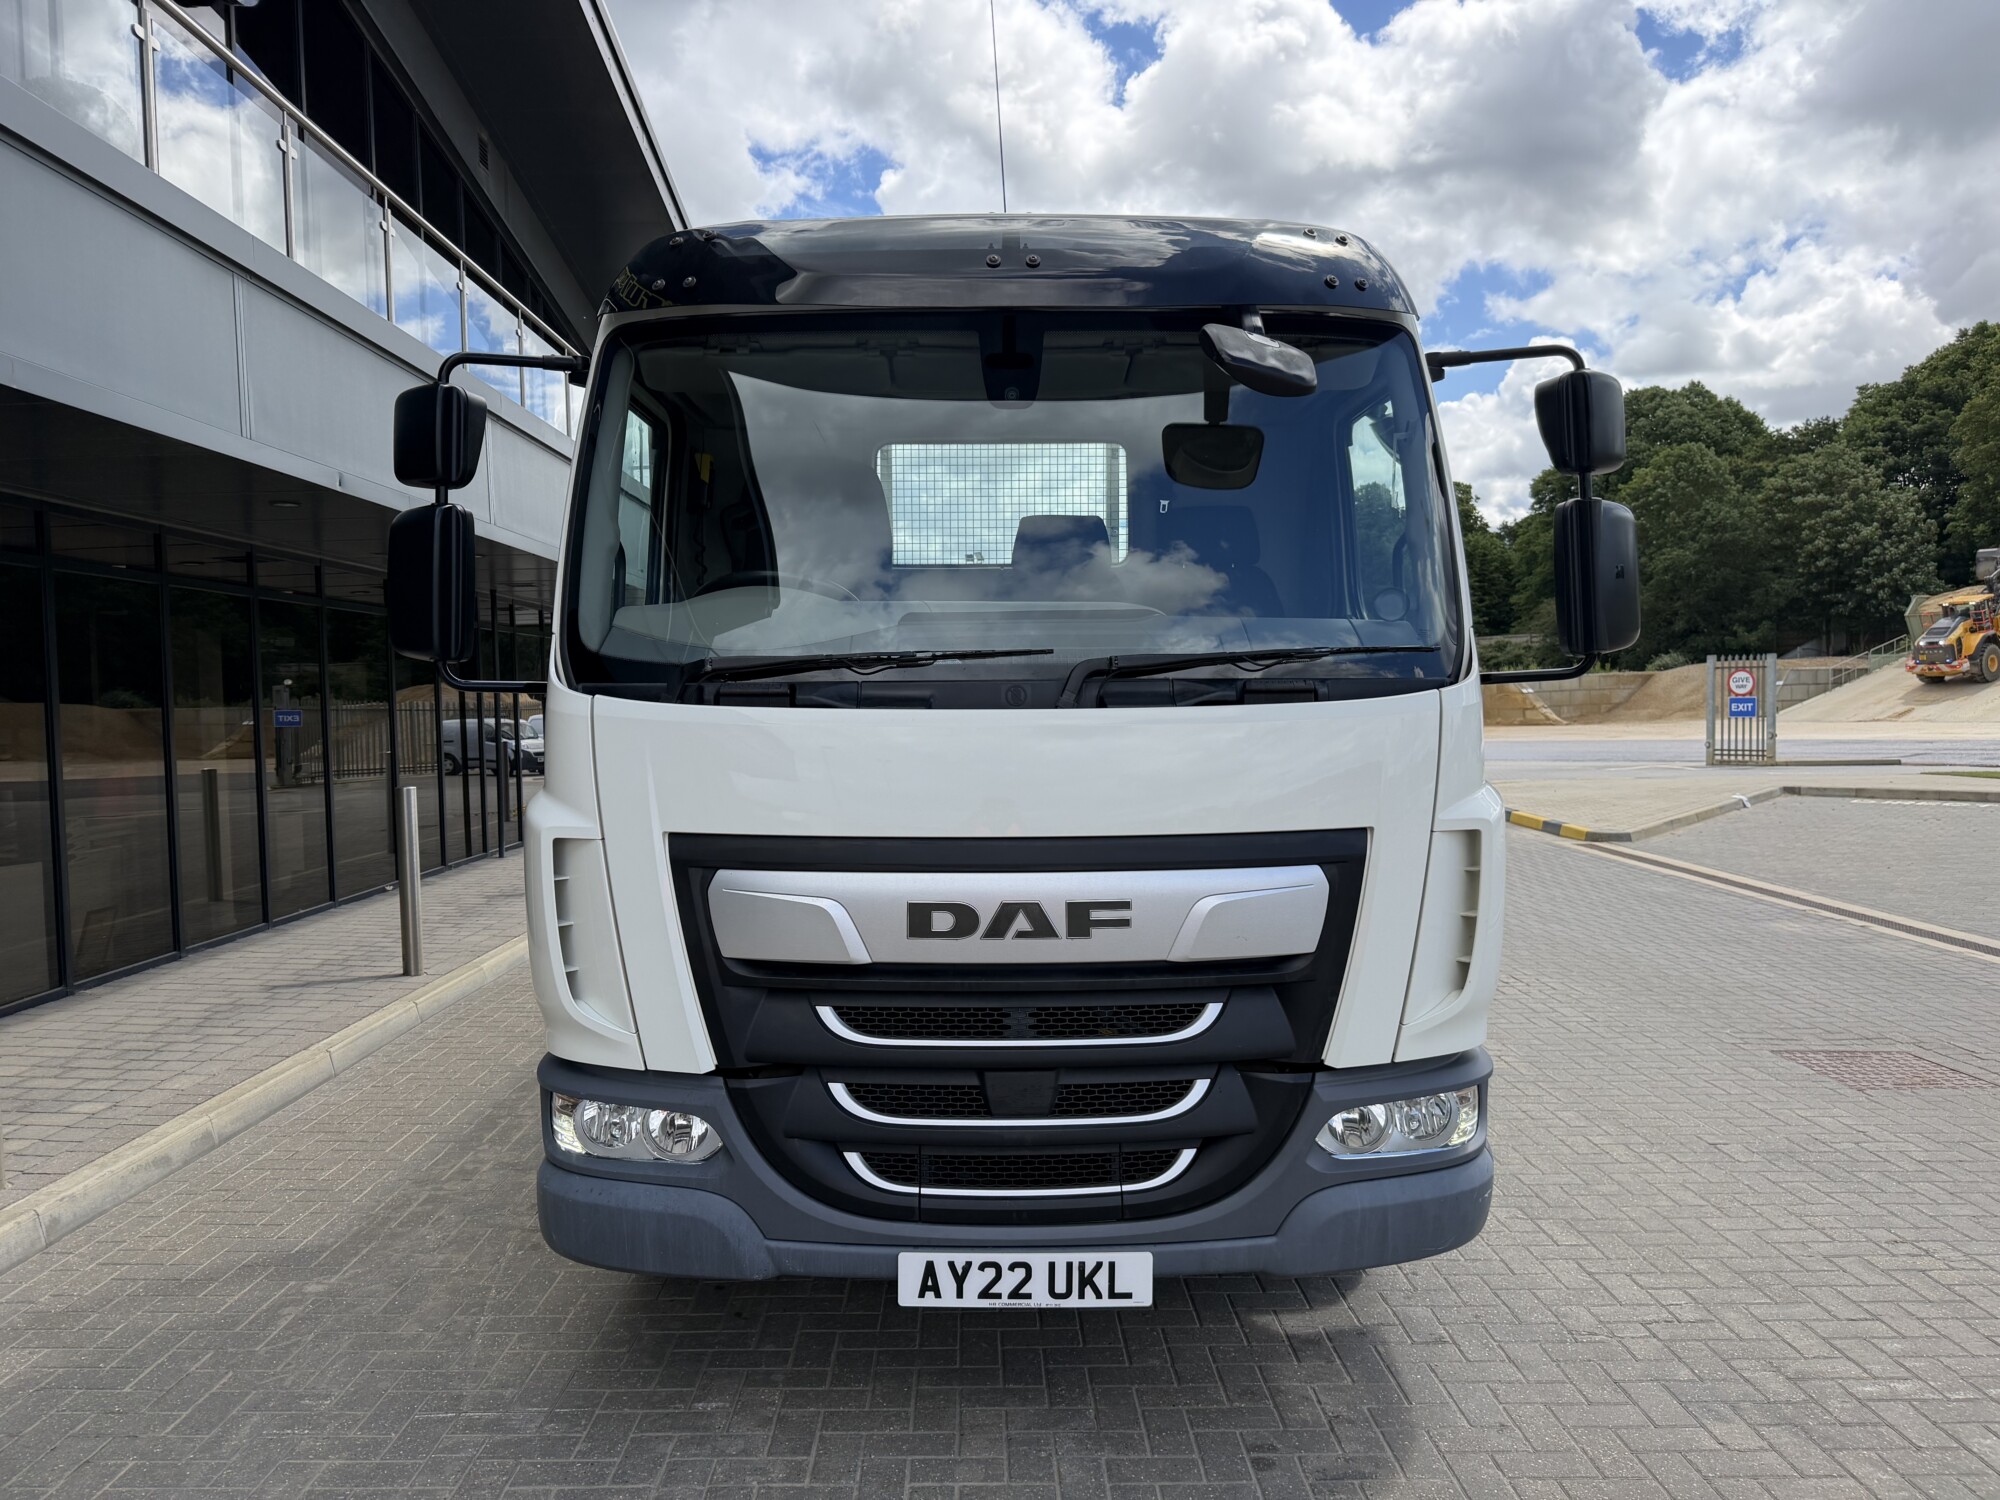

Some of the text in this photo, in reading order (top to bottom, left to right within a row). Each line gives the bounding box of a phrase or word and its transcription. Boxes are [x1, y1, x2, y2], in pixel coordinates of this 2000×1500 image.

[1731, 703, 1753, 712] EXIT
[906, 899, 1133, 941] DAF
[917, 1260, 1133, 1300] AY22 UKL
